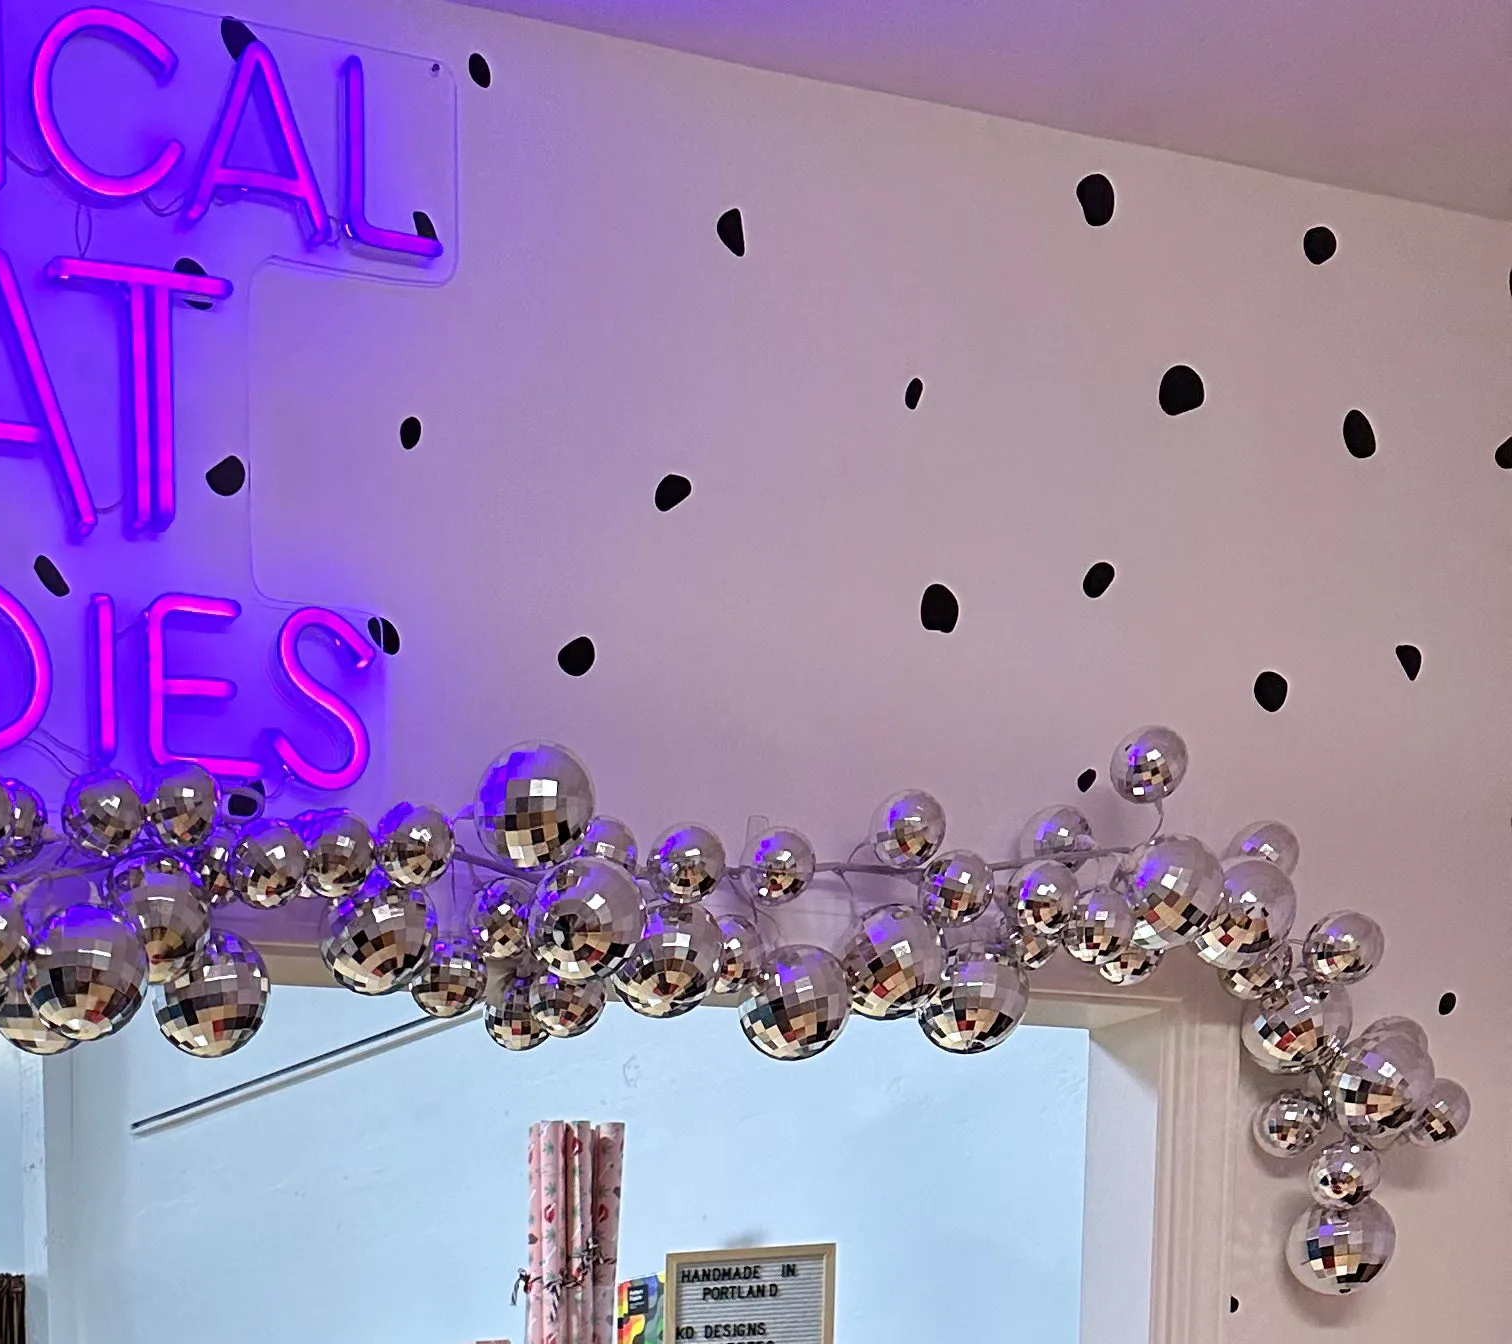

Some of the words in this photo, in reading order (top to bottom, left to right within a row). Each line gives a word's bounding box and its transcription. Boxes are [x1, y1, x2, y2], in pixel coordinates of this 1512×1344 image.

[681, 1264, 762, 1284] HANDMADE
[781, 1263, 798, 1278] IN
[702, 1283, 779, 1301] PORTLAND
[676, 1326, 695, 1340] KD
[704, 1322, 767, 1339] DESIGNS
